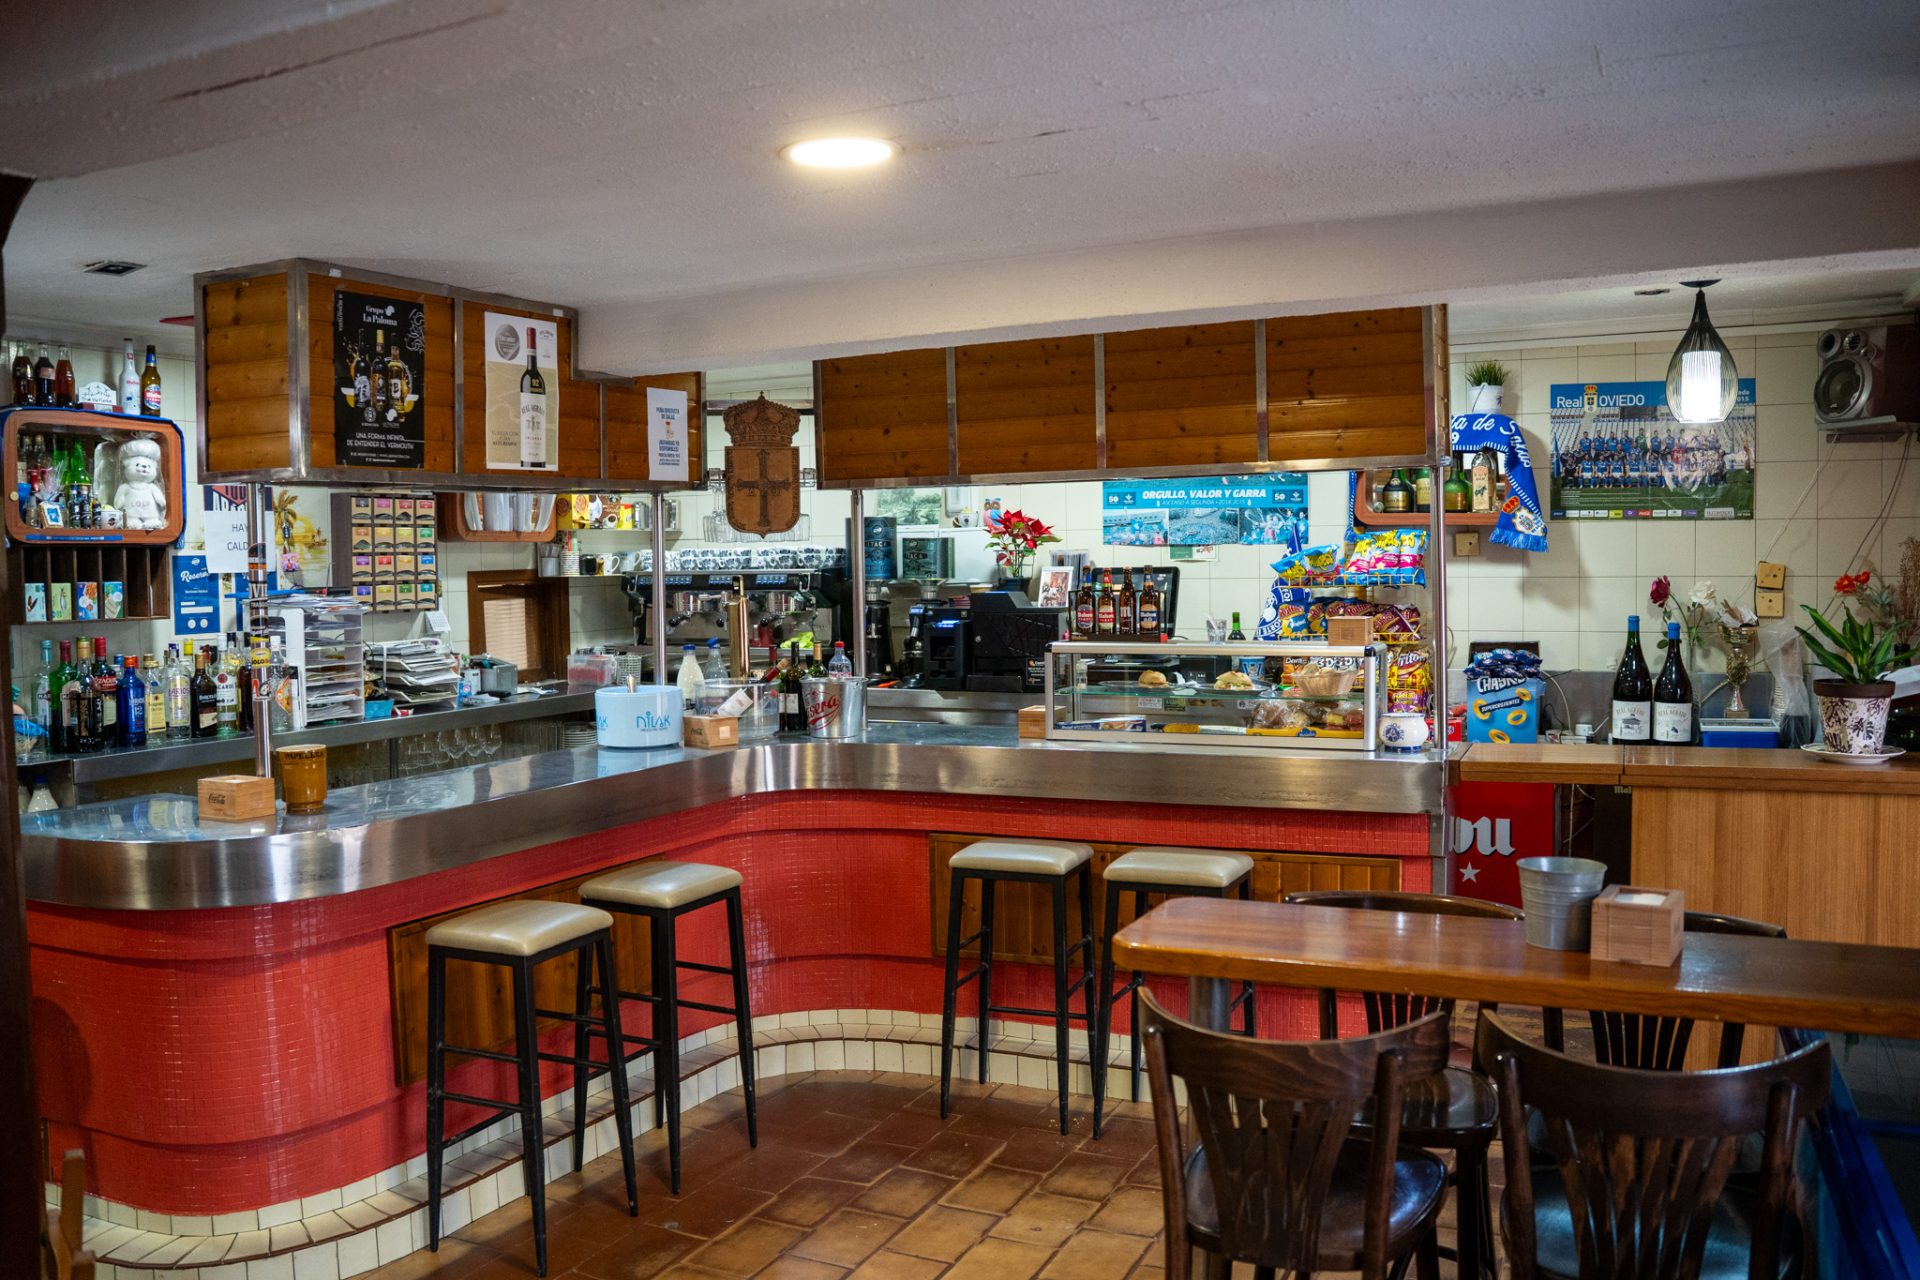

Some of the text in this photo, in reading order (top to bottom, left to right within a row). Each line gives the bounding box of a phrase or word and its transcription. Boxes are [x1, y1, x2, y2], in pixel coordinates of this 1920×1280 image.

[366, 304, 384, 314] Grupo
[362, 313, 398, 326] La Paloma
[1556, 394, 1645, 408] Real OVIEDO
[1472, 414, 1495, 431] de
[1142, 489, 1267, 500] ORGULLO, VALOR Y GARRA
[168, 687, 190, 696] LARIOS
